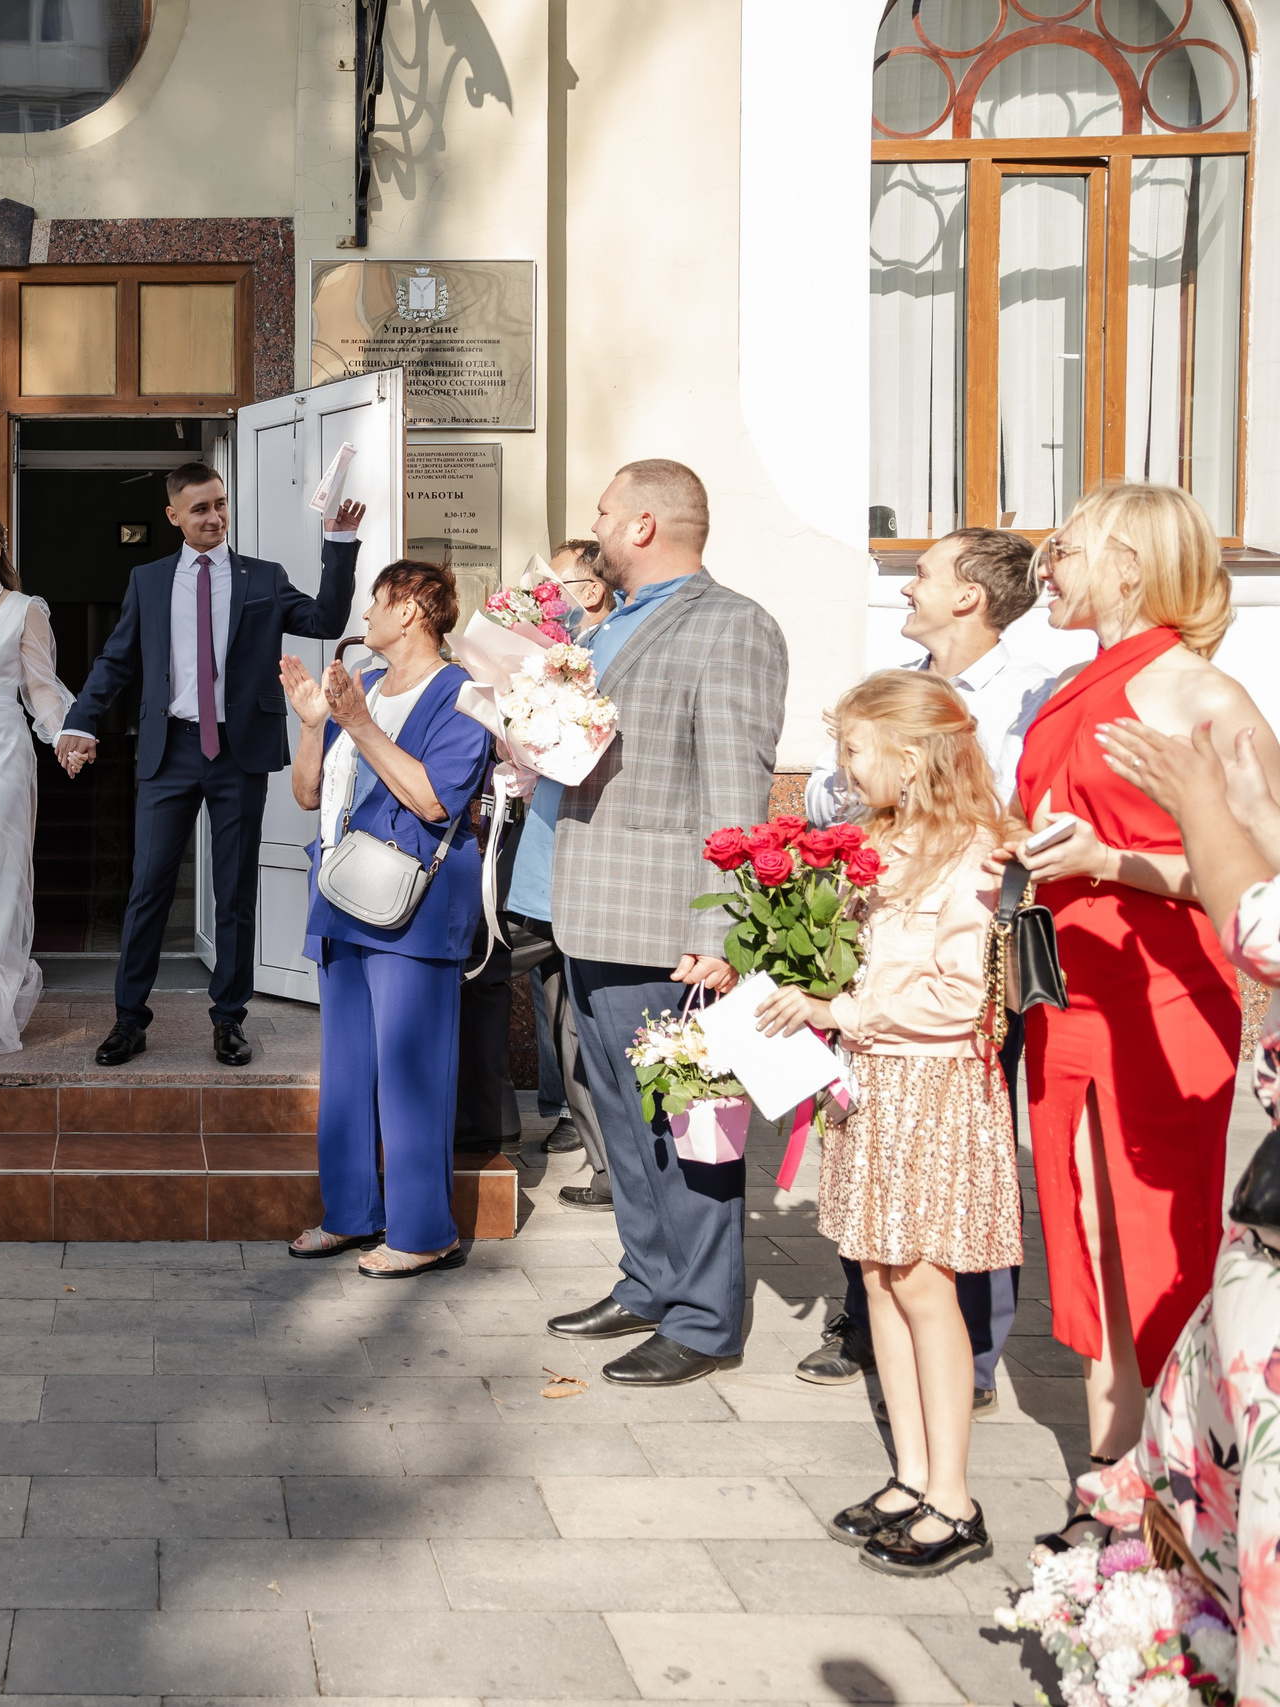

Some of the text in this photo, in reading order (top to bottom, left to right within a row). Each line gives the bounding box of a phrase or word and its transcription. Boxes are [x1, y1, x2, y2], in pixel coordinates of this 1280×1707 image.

[383, 324, 459, 335] Управление
[348, 359, 496, 369] СПЕЦИАЛИЗИРОВАННЫЙ ОТДЕЛ
[437, 370, 503, 378] РЕГИСТРАЦИИ
[449, 379, 506, 387] СОСТОЯНИЯ
[418, 491, 464, 499] РАБОТЫ
